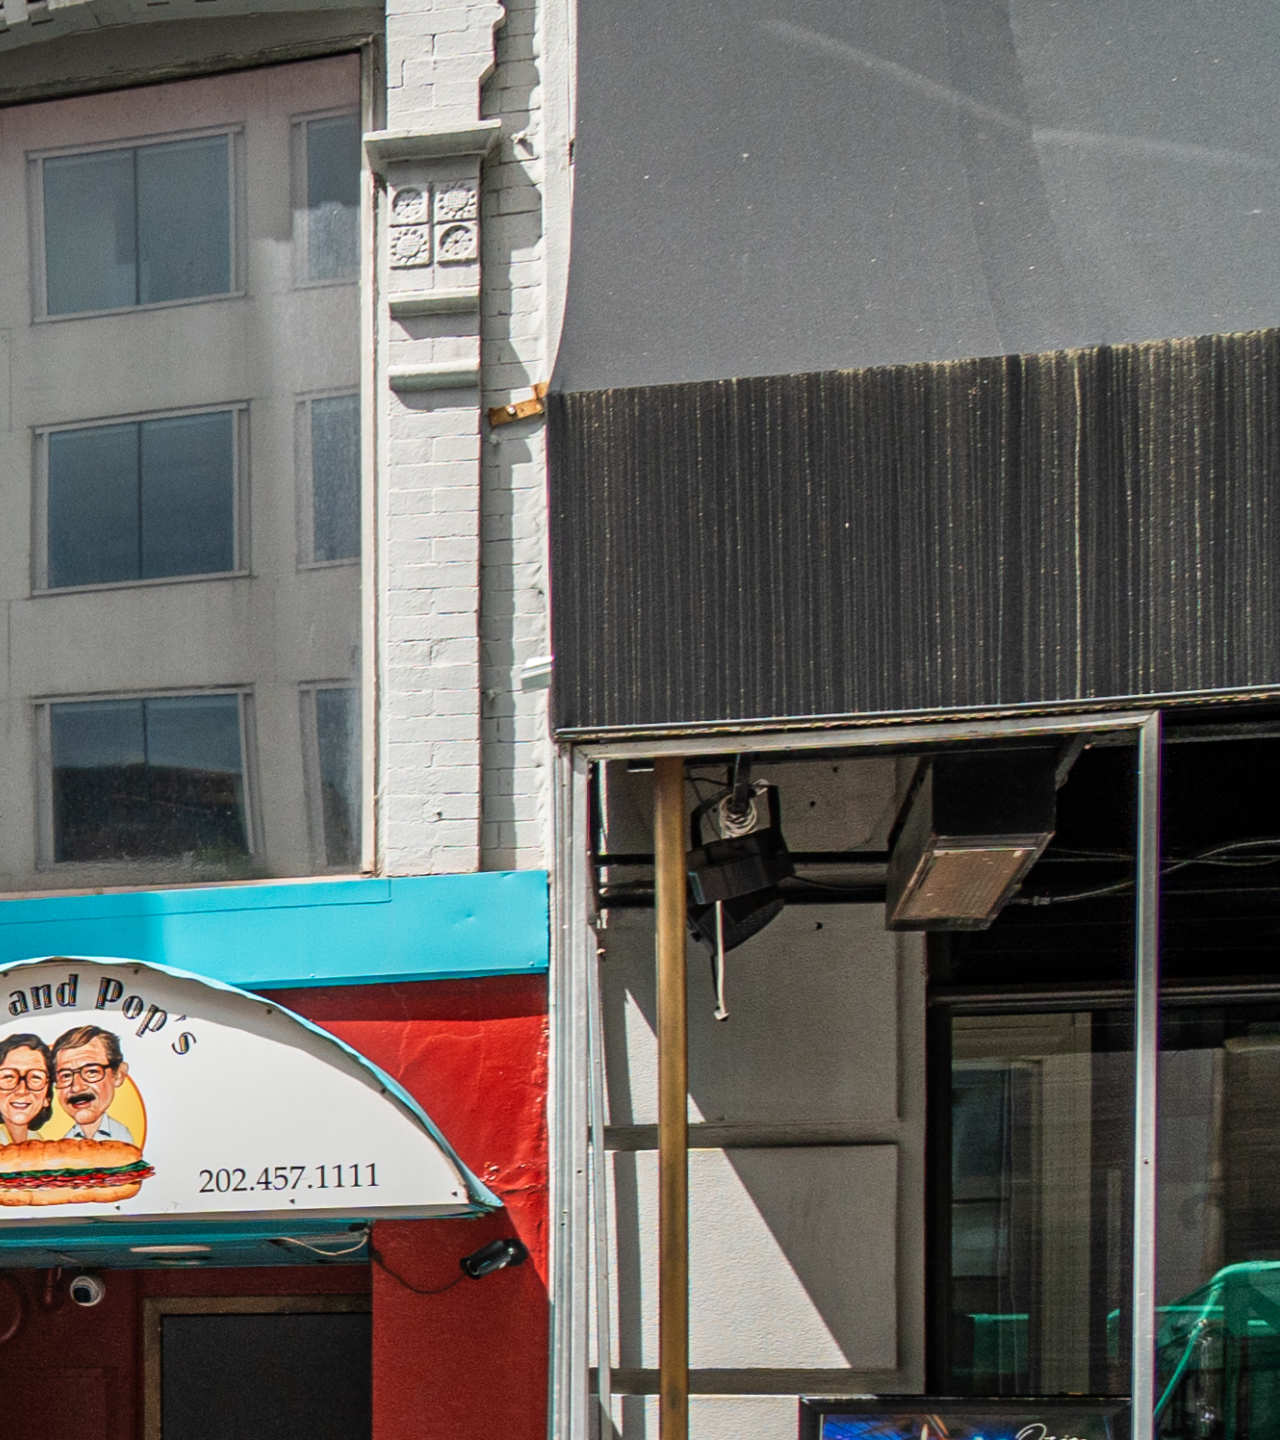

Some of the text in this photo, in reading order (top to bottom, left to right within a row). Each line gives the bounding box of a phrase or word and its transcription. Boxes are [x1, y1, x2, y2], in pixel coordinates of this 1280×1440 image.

[8, 974, 80, 1016] and
[95, 976, 197, 1055] Pop's
[198, 1162, 380, 1194] 202.457.1111
